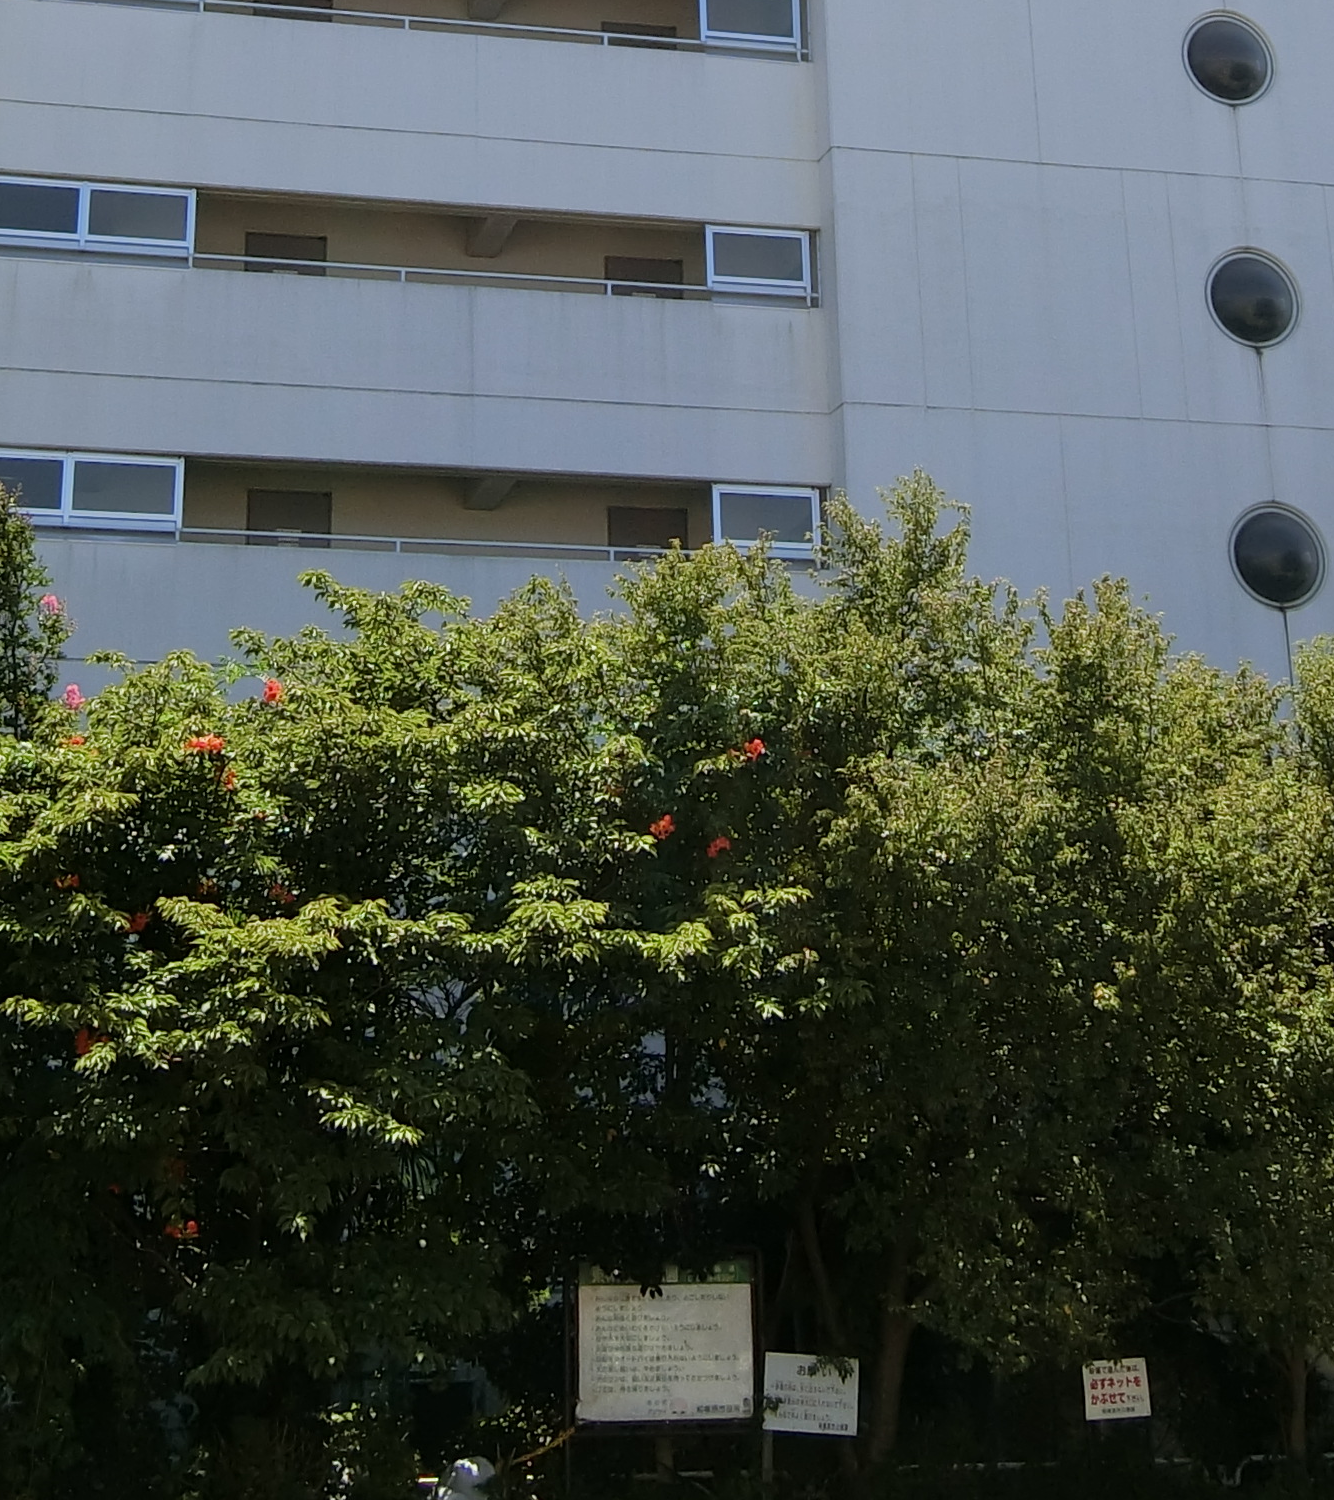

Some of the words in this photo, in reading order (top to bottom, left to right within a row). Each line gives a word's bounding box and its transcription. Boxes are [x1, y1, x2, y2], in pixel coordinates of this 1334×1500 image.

[1089, 1376, 1141, 1390] 必ずネットを
